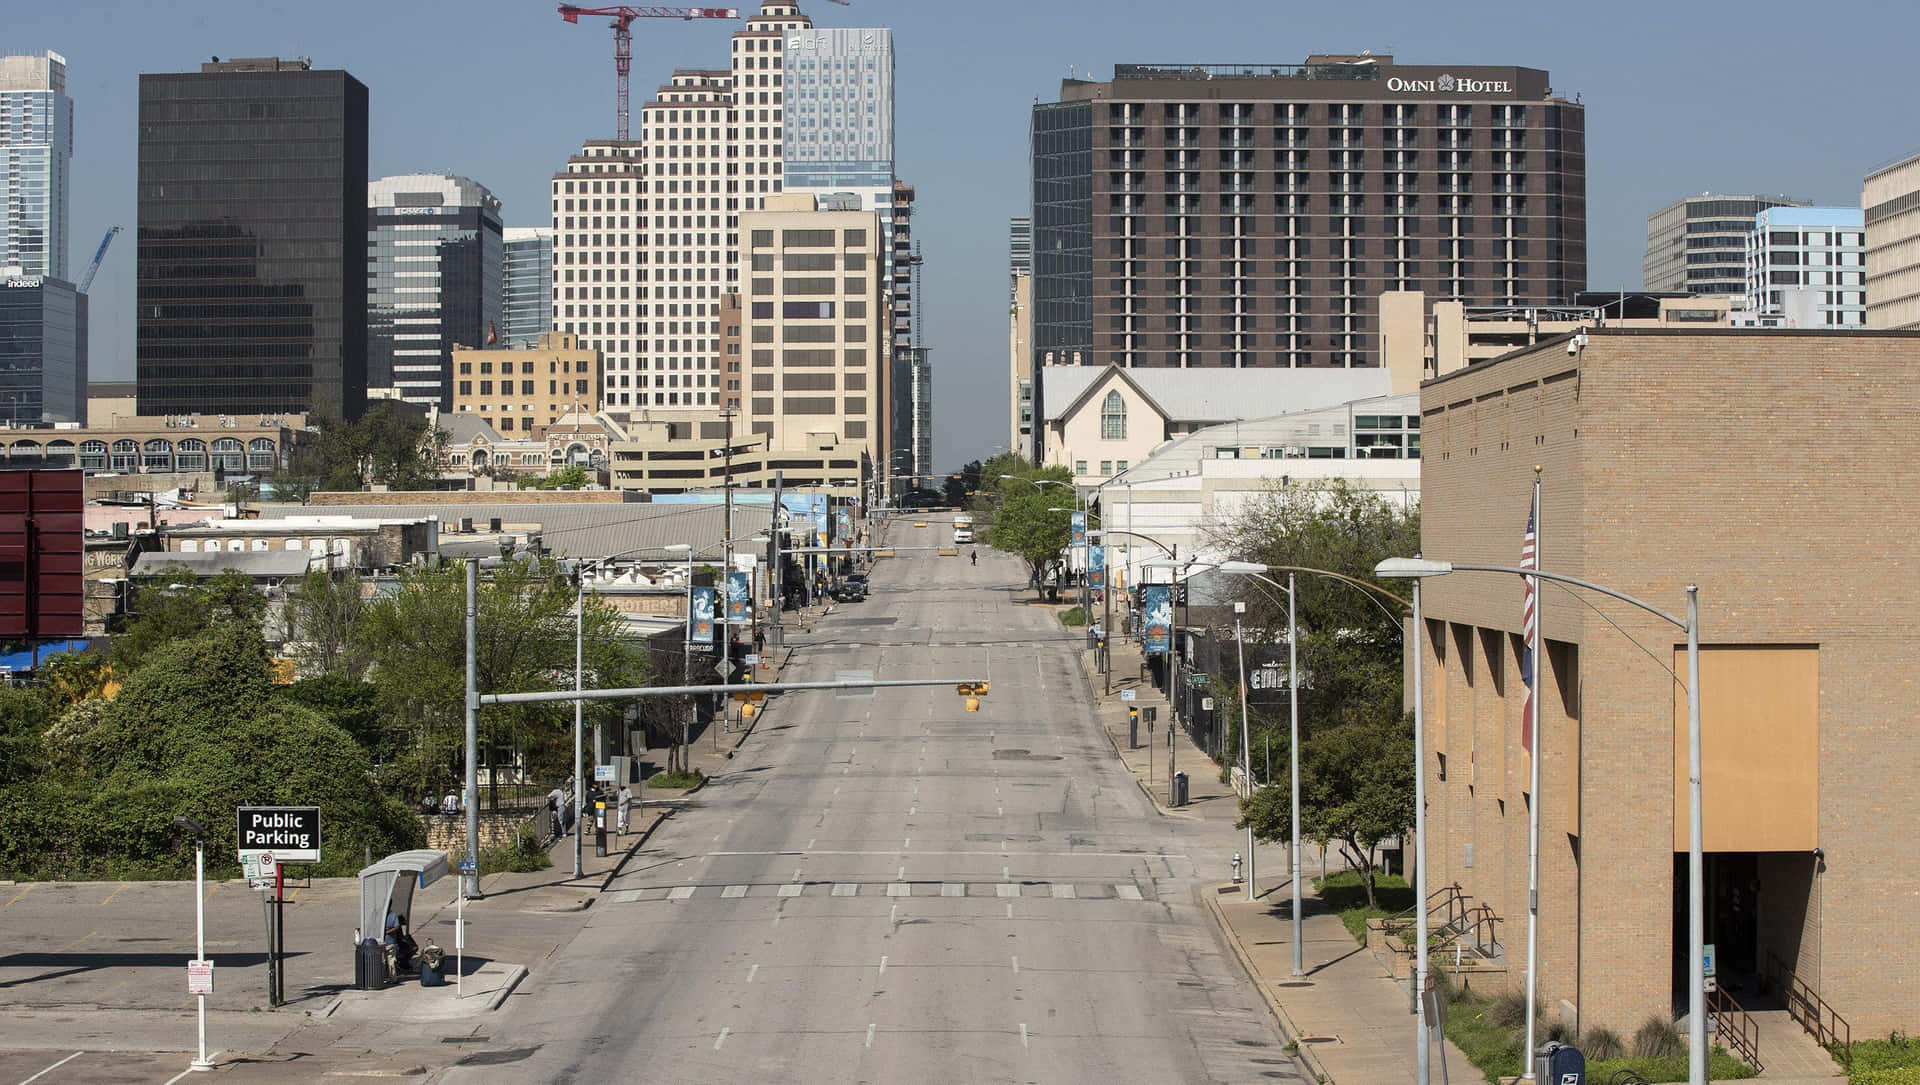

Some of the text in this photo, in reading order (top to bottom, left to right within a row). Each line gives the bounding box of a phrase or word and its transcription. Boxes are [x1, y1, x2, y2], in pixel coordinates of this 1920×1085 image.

[1387, 77, 1512, 92] OMNI HOTEL
[8, 279, 40, 288] indeed
[1250, 669, 1315, 689] EMPRE
[252, 813, 303, 828] Public
[246, 830, 310, 848] Parking
